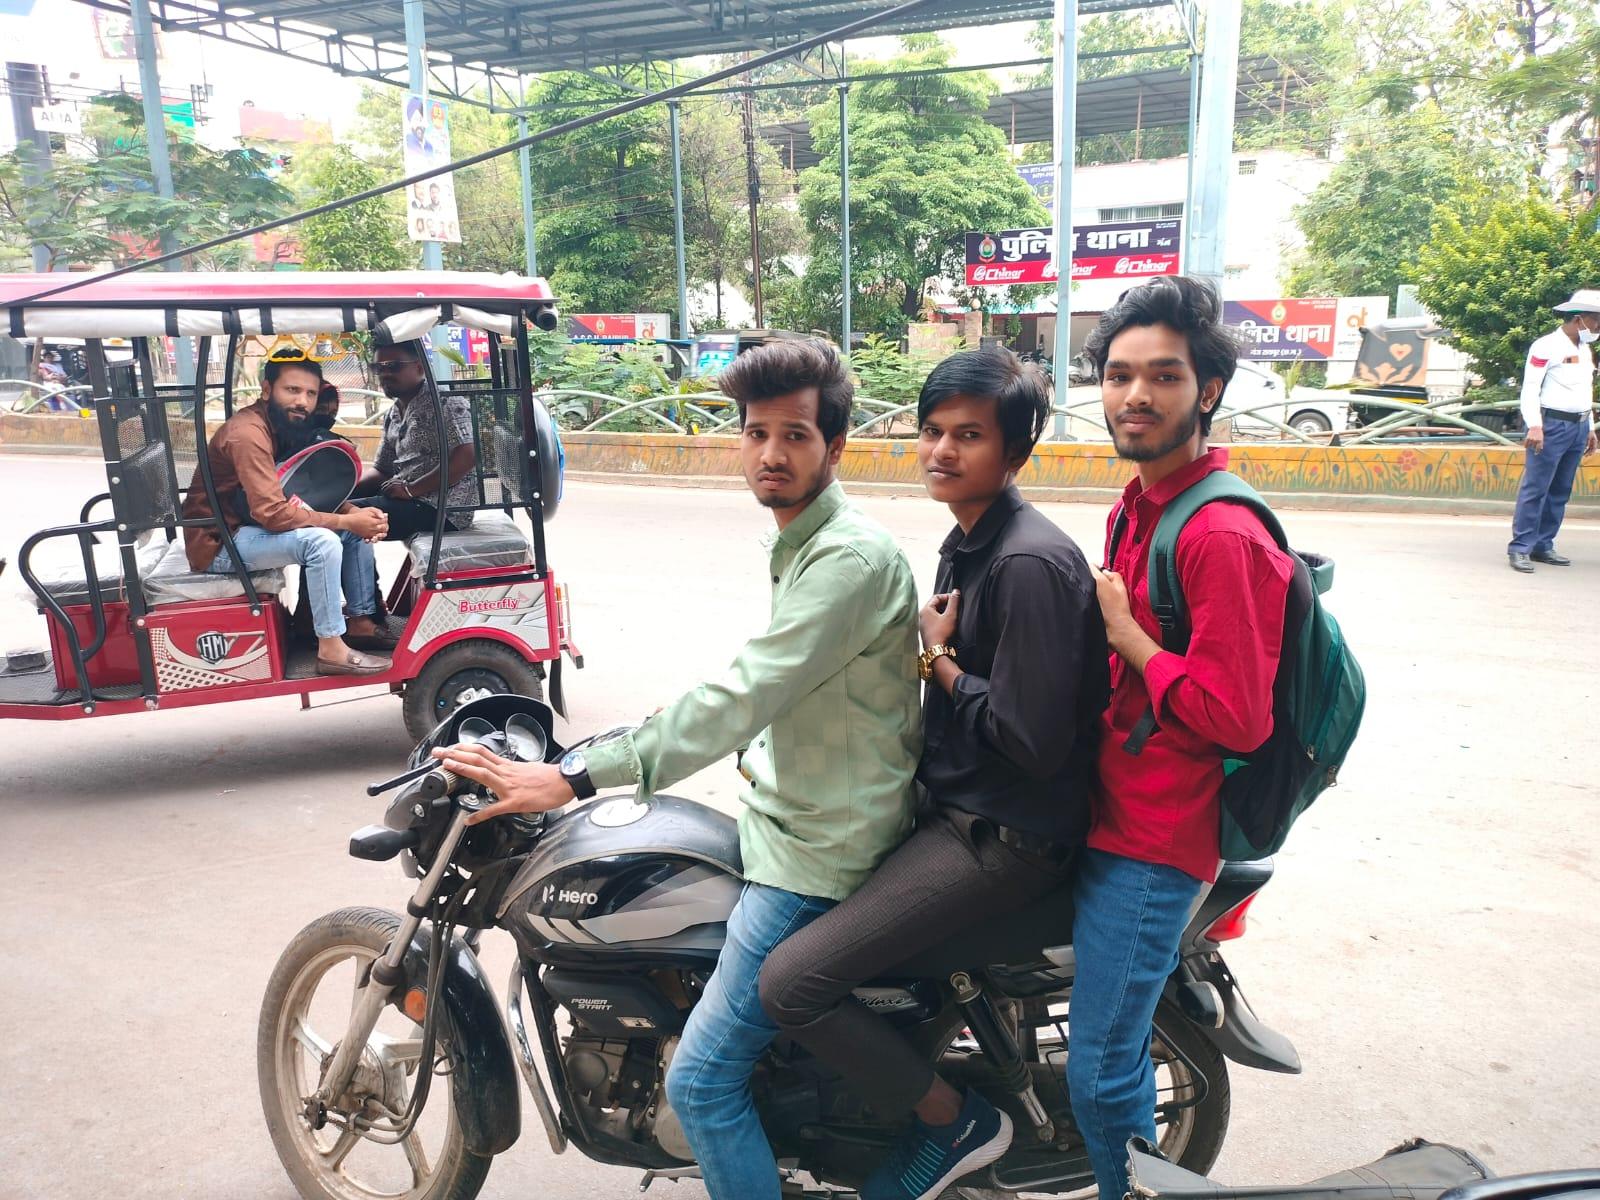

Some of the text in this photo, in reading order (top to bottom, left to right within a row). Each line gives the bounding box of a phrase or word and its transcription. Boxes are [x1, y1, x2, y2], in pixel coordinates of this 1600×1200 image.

[1001, 228, 1152, 262] पुलि थाना
[984, 266, 1026, 280] Chinar
[1127, 259, 1172, 273] Chinar
[1285, 324, 1332, 343] थाना
[459, 598, 519, 614] Butterfly
[201, 634, 225, 660] HM
[558, 890, 598, 905] Hero
